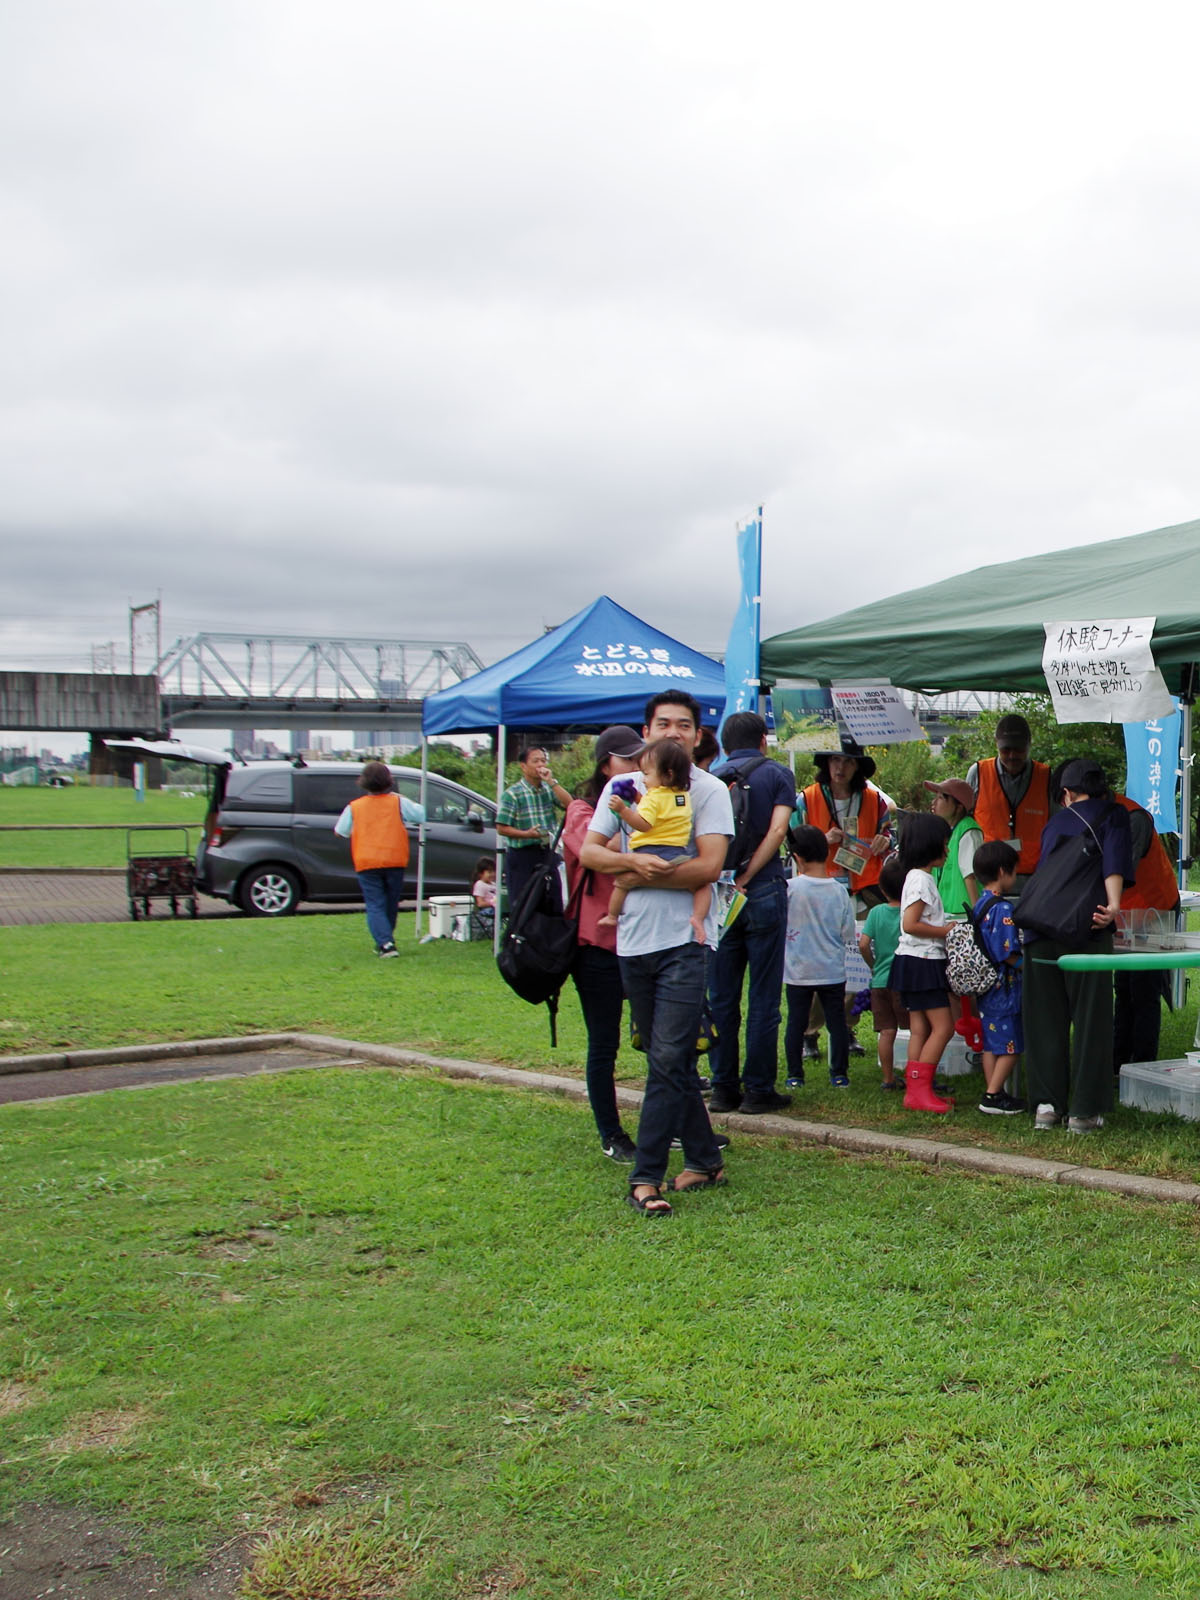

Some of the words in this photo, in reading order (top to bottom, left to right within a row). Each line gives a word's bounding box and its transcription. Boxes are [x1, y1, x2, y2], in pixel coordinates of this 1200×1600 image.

[1058, 625, 1144, 653] 体験コーナー
[582, 643, 670, 662] とどろき
[574, 662, 696, 678] 水辺の楽校
[1051, 660, 1131, 677] 多摩川の生き物を
[1056, 679, 1143, 697] 図鑑で見分けよう
